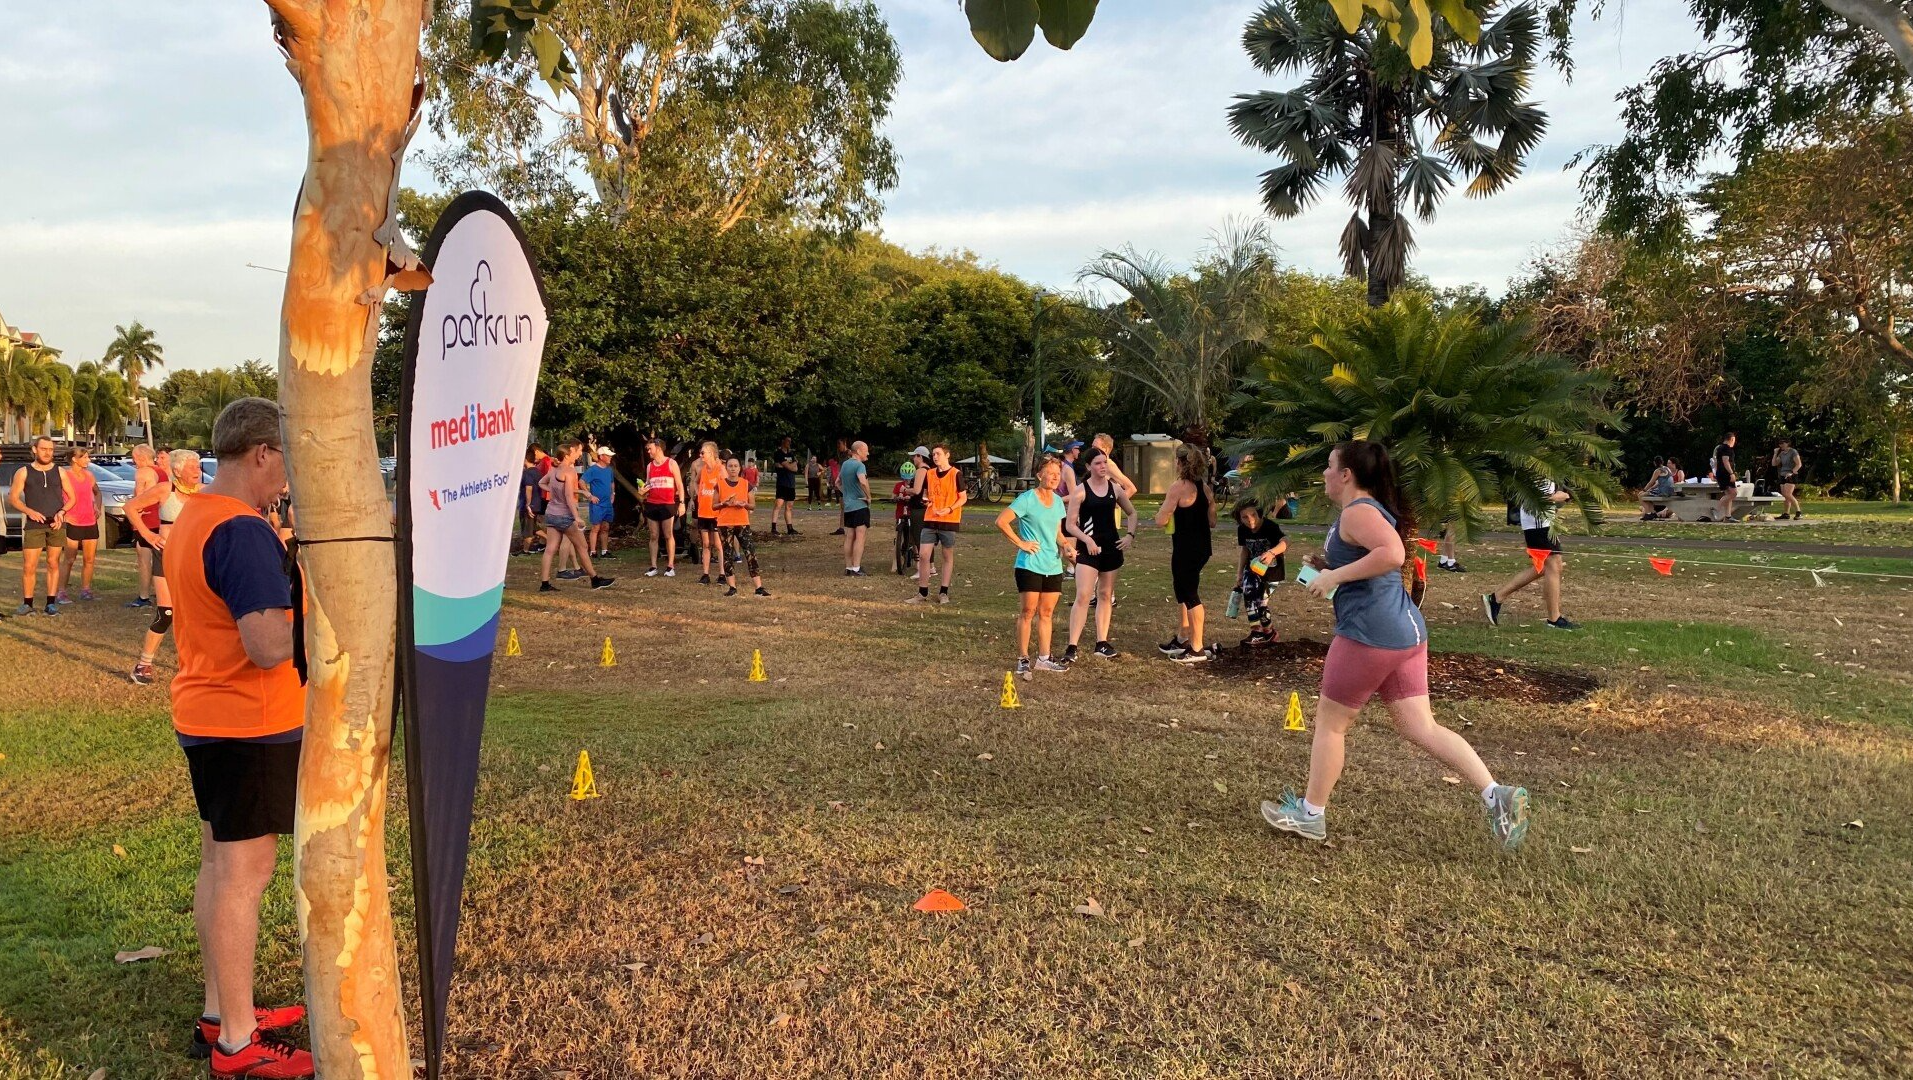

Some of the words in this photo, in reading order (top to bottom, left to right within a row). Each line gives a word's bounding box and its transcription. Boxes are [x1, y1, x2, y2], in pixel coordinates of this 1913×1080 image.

[442, 290, 532, 360] parkrun
[431, 399, 515, 449] medibank
[442, 488, 458, 504] The
[459, 478, 493, 499] Athlete's
